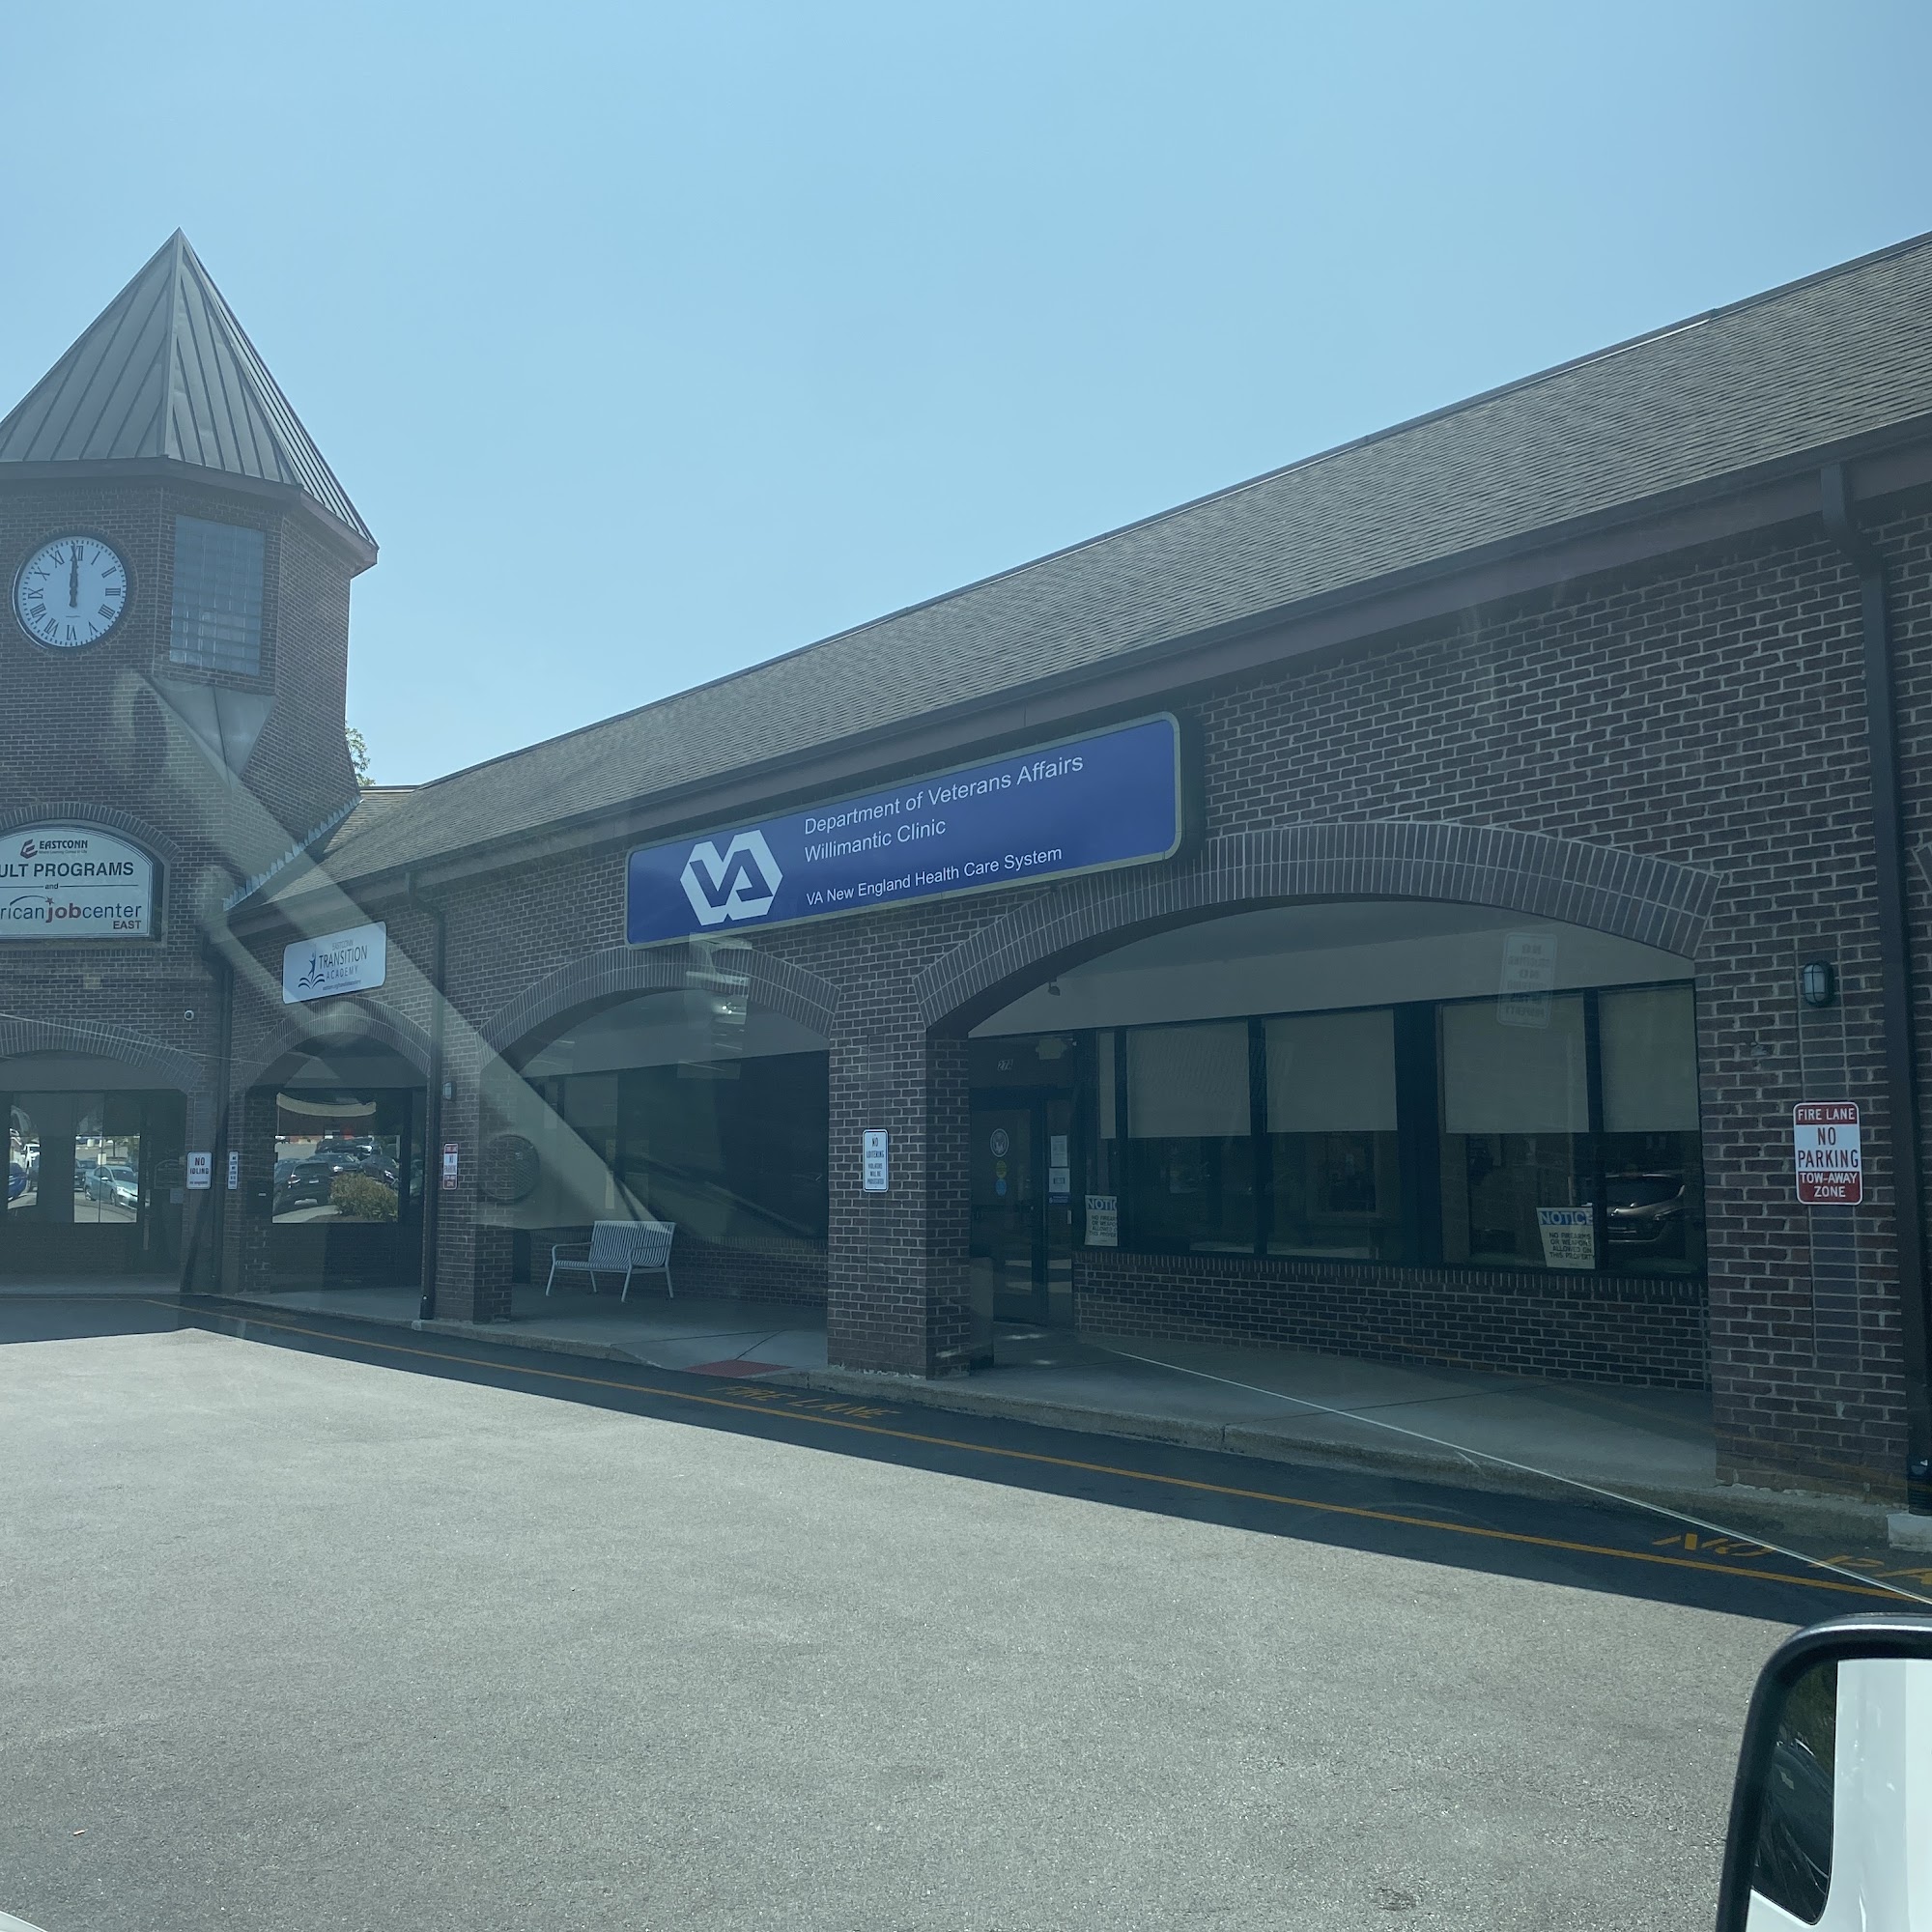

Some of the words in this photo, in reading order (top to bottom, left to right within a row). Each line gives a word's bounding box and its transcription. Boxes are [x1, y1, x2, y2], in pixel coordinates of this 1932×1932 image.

[34, 566, 50, 581] X
[105, 587, 121, 596] III
[66, 624, 76, 640] VI
[88, 621, 99, 636] V
[805, 798, 900, 835] Department
[905, 791, 923, 811] of
[928, 774, 1011, 806] Veterans
[1016, 756, 1083, 785] Affairs
[40, 839, 88, 850] EASTCONN
[805, 831, 892, 863] Willimantic
[897, 818, 946, 842] Clinic
[34, 862, 134, 877] PROGRAMS
[806, 891, 824, 906] VA
[827, 888, 854, 902] New
[858, 874, 910, 897] England
[915, 866, 959, 887] Health
[964, 861, 1000, 877] Care
[1004, 848, 1063, 871] System
[113, 921, 142, 929] EAST
[319, 945, 368, 970] TRANSITION
[327, 965, 358, 980] ACADEMY
[1798, 1109, 1822, 1122] FIRE
[1826, 1108, 1855, 1121] LANE
[1817, 1126, 1836, 1146] NO
[194, 1157, 206, 1166] NO
[1798, 1149, 1859, 1168] PARKING
[1800, 1172, 1858, 1184] TOW-AWAY
[1813, 1185, 1846, 1198] ZONE
[1539, 1211, 1593, 1226] NOTICE
[1653, 1533, 1776, 1557] NO
